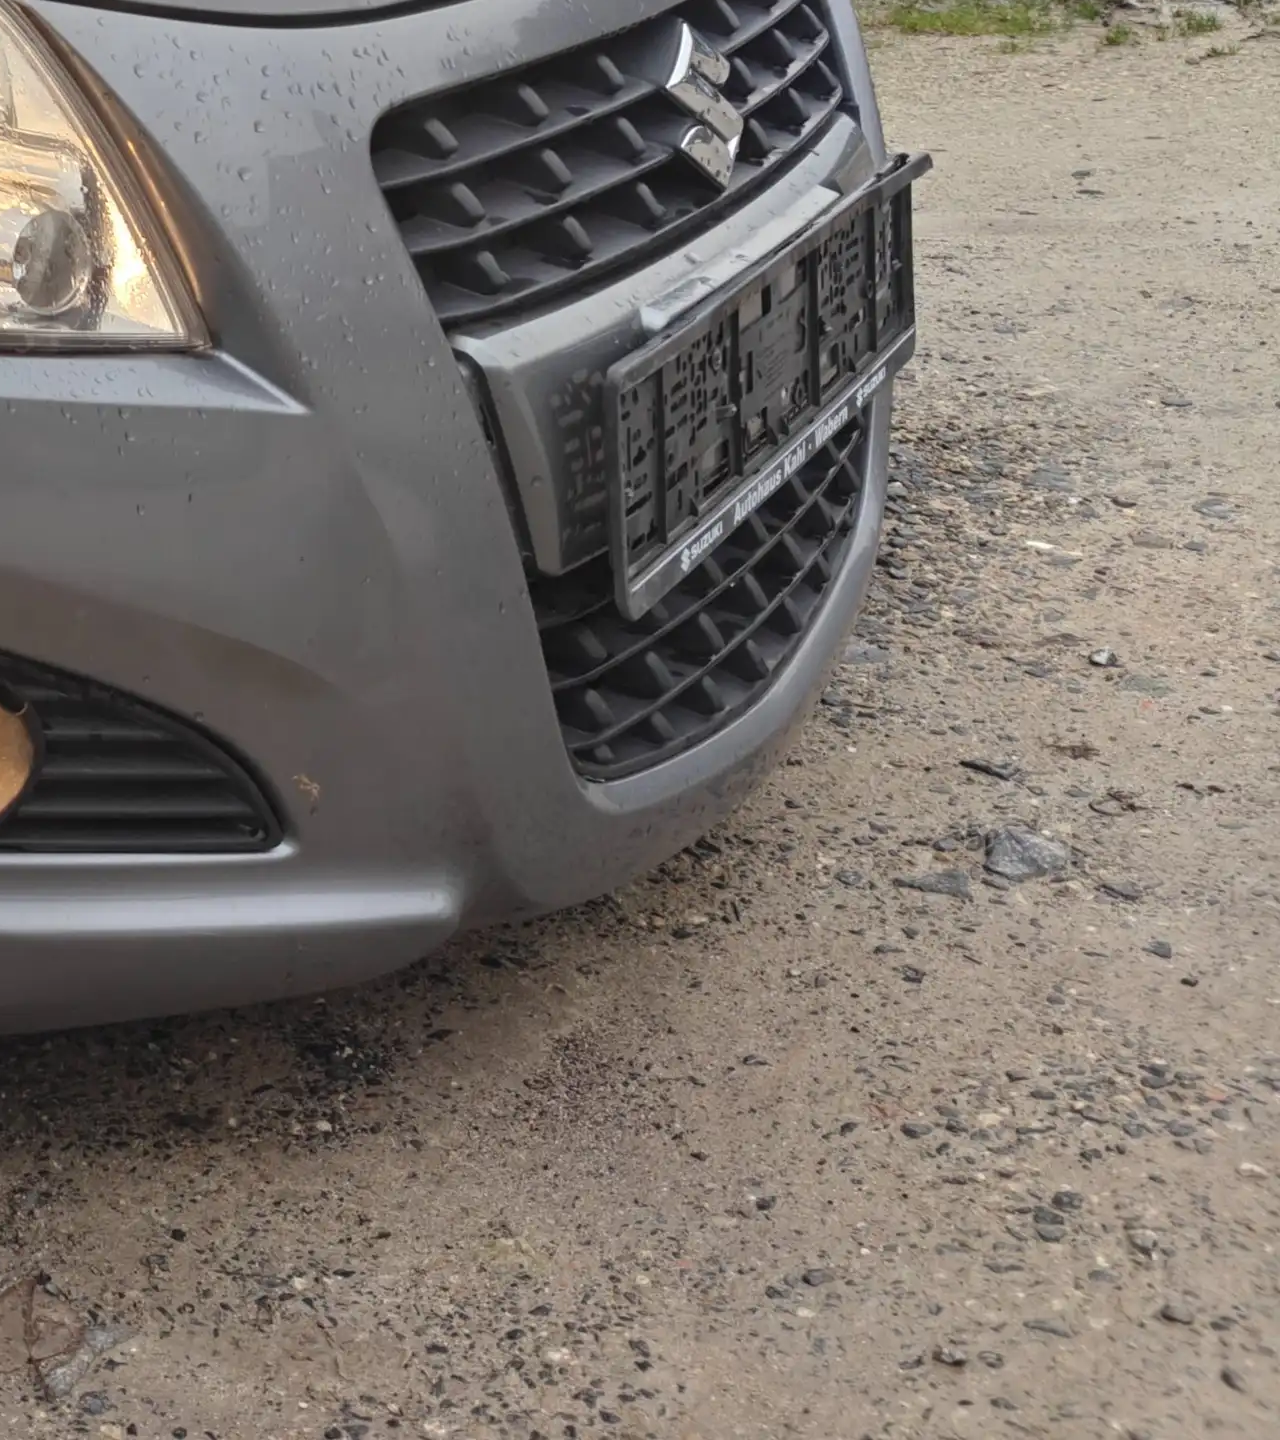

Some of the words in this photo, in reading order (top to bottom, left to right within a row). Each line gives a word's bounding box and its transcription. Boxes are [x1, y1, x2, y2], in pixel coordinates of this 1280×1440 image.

[690, 521, 724, 559] SUZUKI
[733, 471, 782, 526] Autohaus
[783, 440, 806, 478] Kahl
[814, 406, 848, 448] Wabern
[862, 365, 886, 398] SUZUKI
